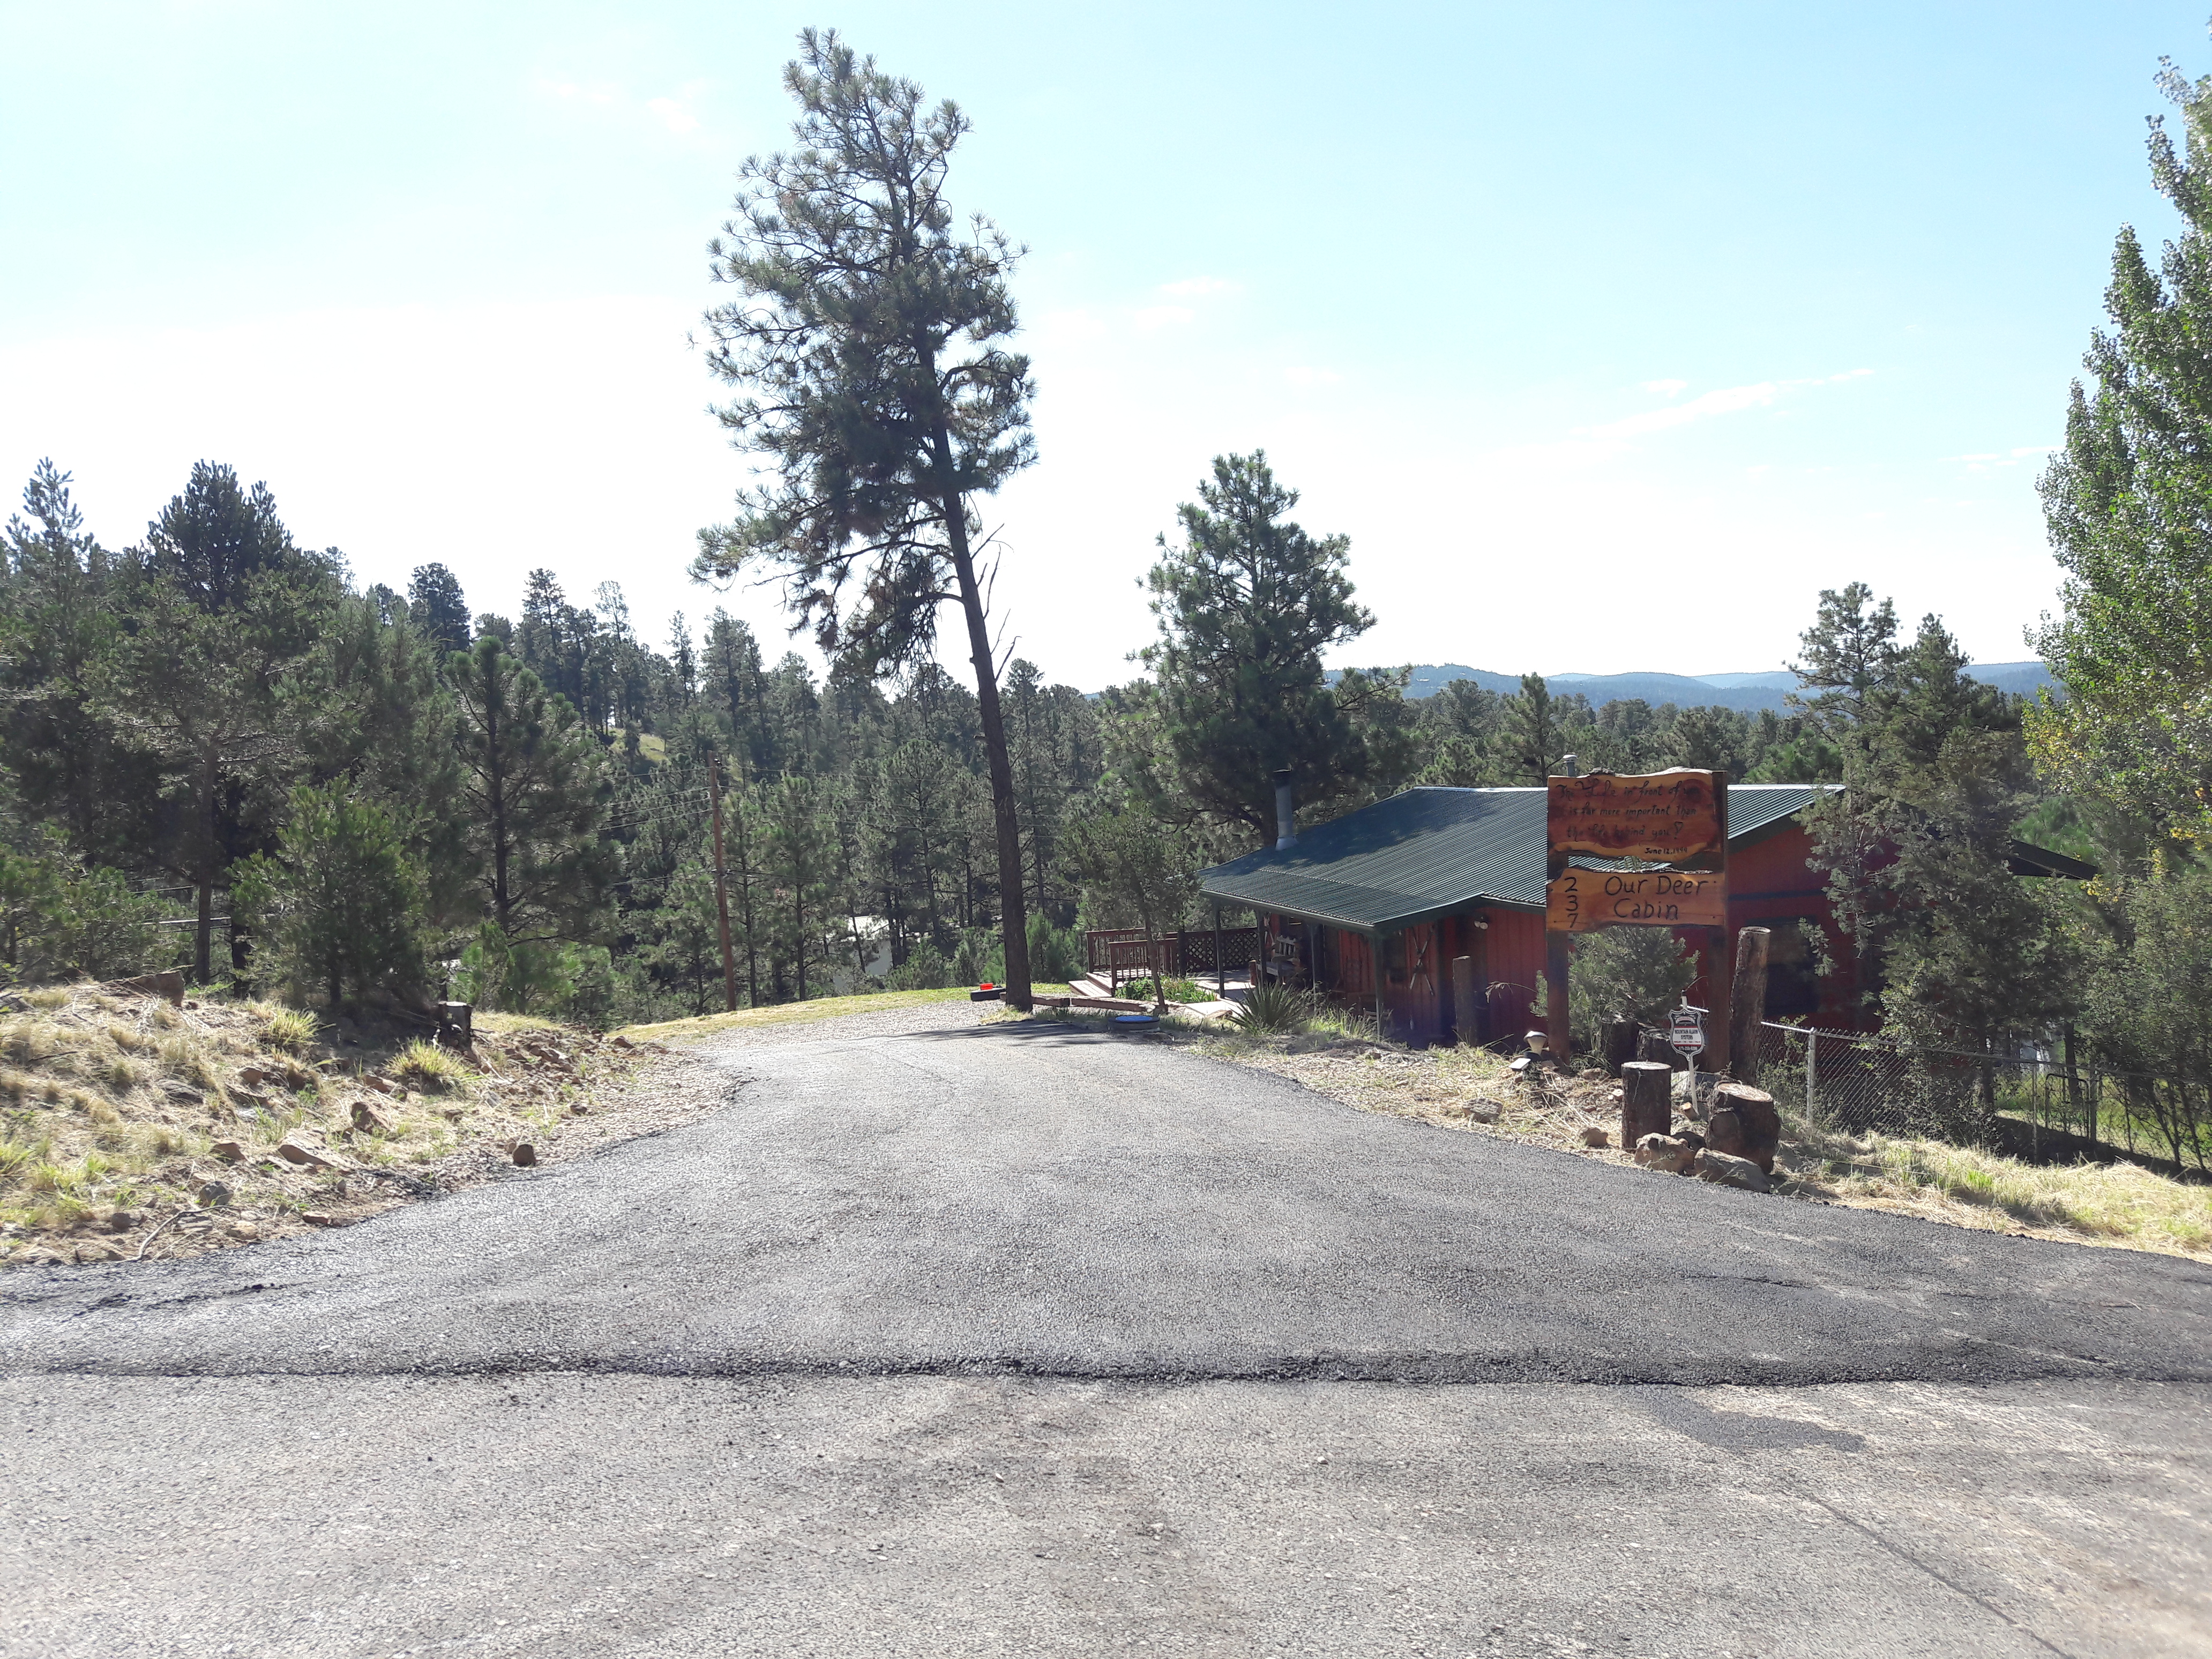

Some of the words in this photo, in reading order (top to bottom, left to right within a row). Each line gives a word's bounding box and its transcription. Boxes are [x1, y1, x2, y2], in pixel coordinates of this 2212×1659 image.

[1624, 786, 1633, 796] in
[1632, 780, 1663, 804] front
[1668, 780, 1682, 803] of
[1626, 805, 1670, 818] important
[1604, 876, 1649, 895] Our
[1655, 875, 1708, 895] Deer
[1612, 898, 1679, 921] Cabin
